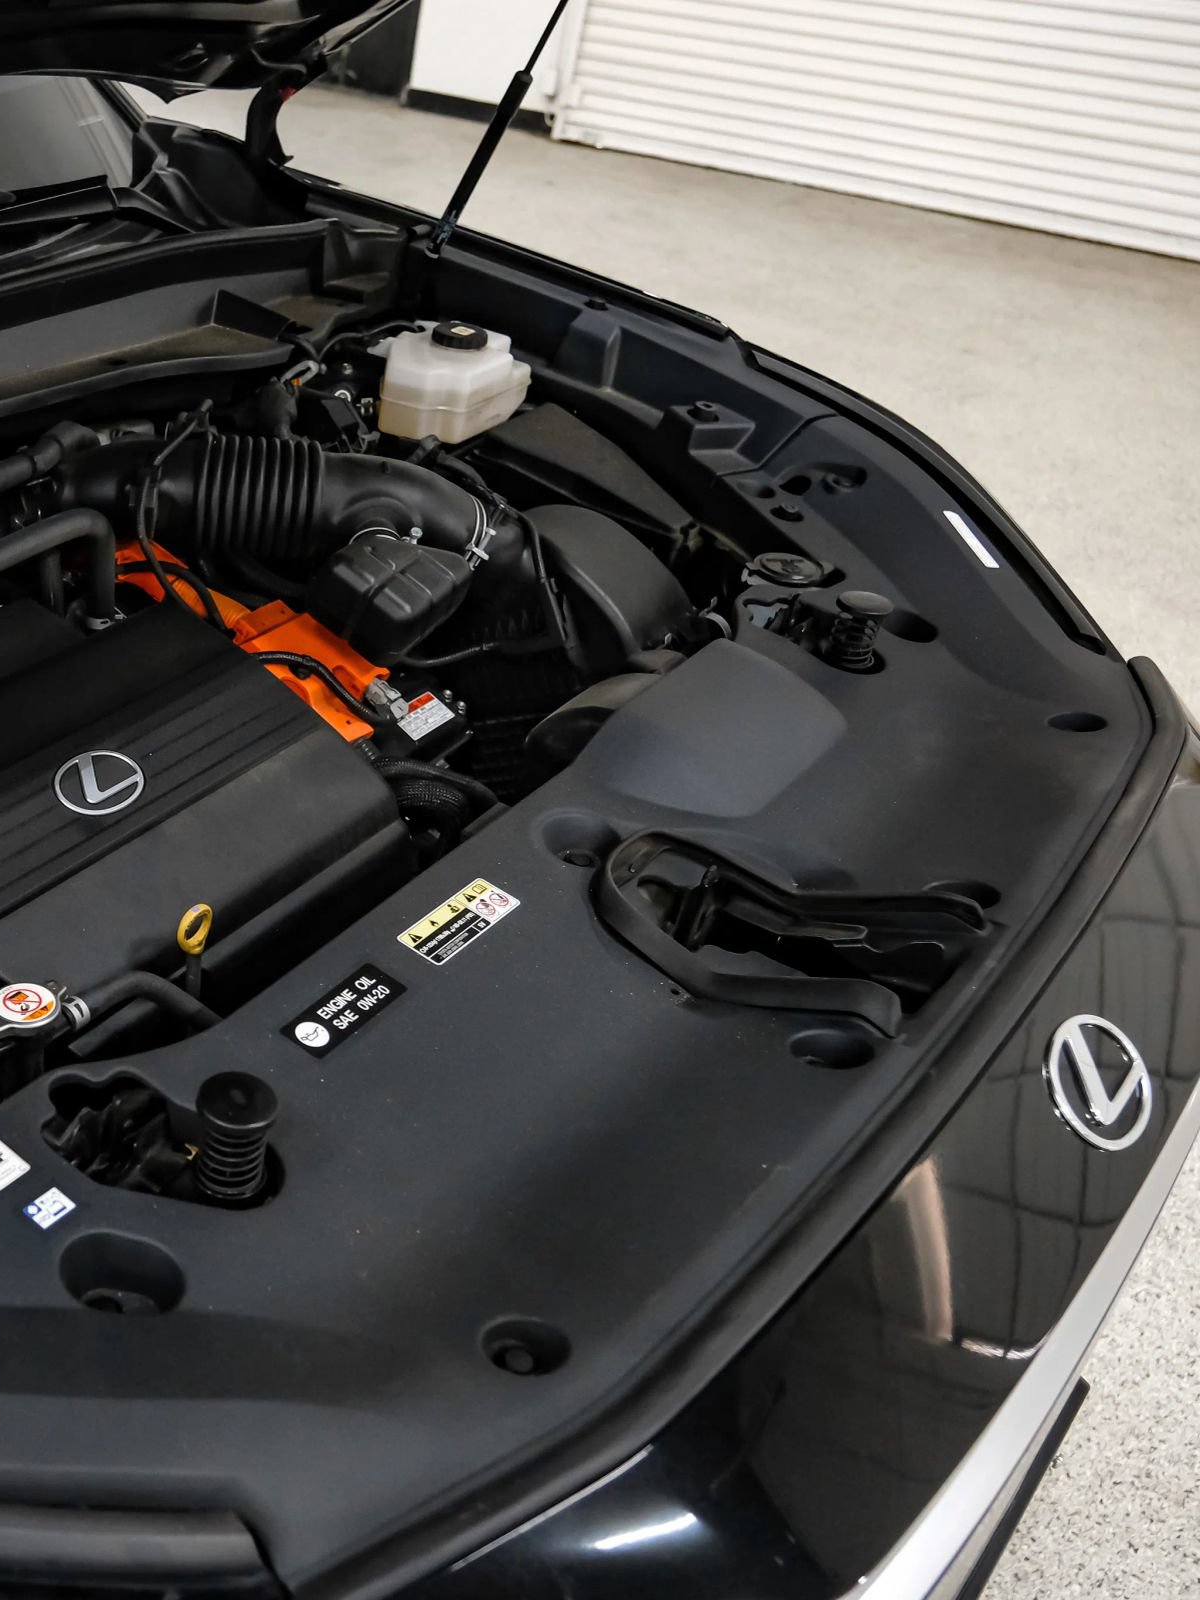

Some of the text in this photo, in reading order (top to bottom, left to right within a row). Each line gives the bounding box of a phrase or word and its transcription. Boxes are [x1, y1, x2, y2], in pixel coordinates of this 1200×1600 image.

[316, 976, 377, 1020] ENGINE OIL
[332, 985, 391, 1030] SAE 0W-20
